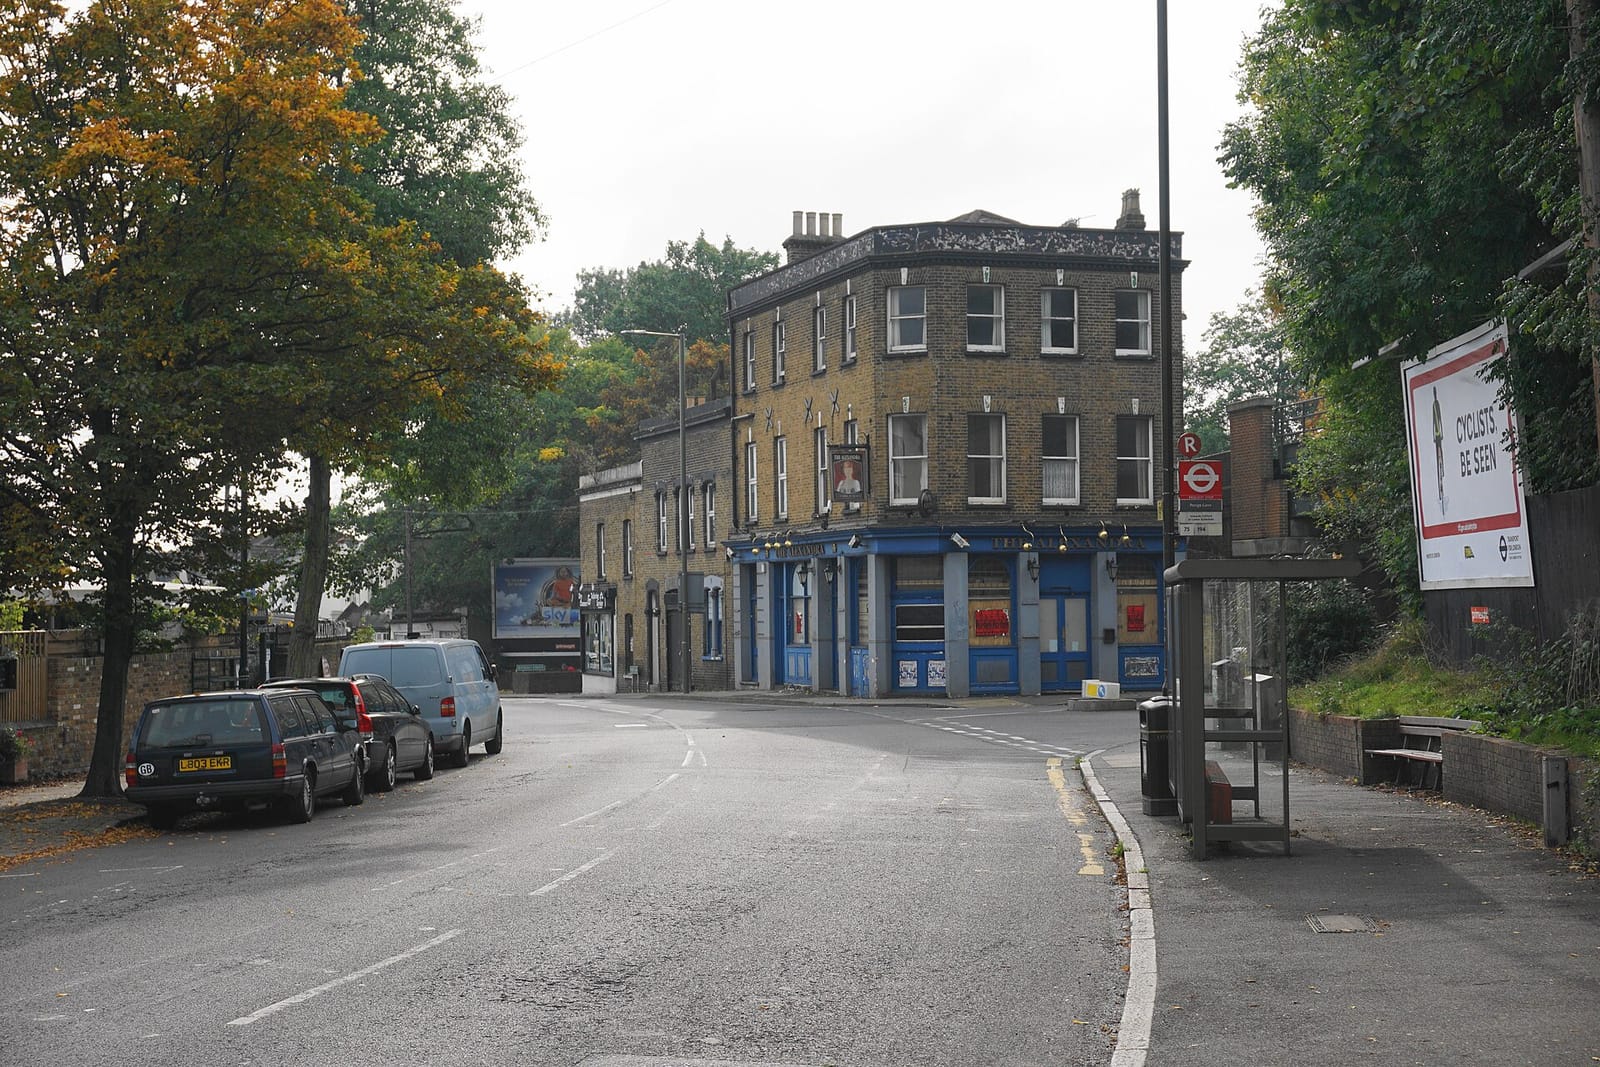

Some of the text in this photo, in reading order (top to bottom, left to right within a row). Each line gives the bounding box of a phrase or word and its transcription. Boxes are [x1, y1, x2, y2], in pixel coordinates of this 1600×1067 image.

[1184, 436, 1197, 453] R
[1460, 442, 1497, 478] BE SEEN
[209, 757, 230, 767] EKR
[140, 764, 153, 775] GB
